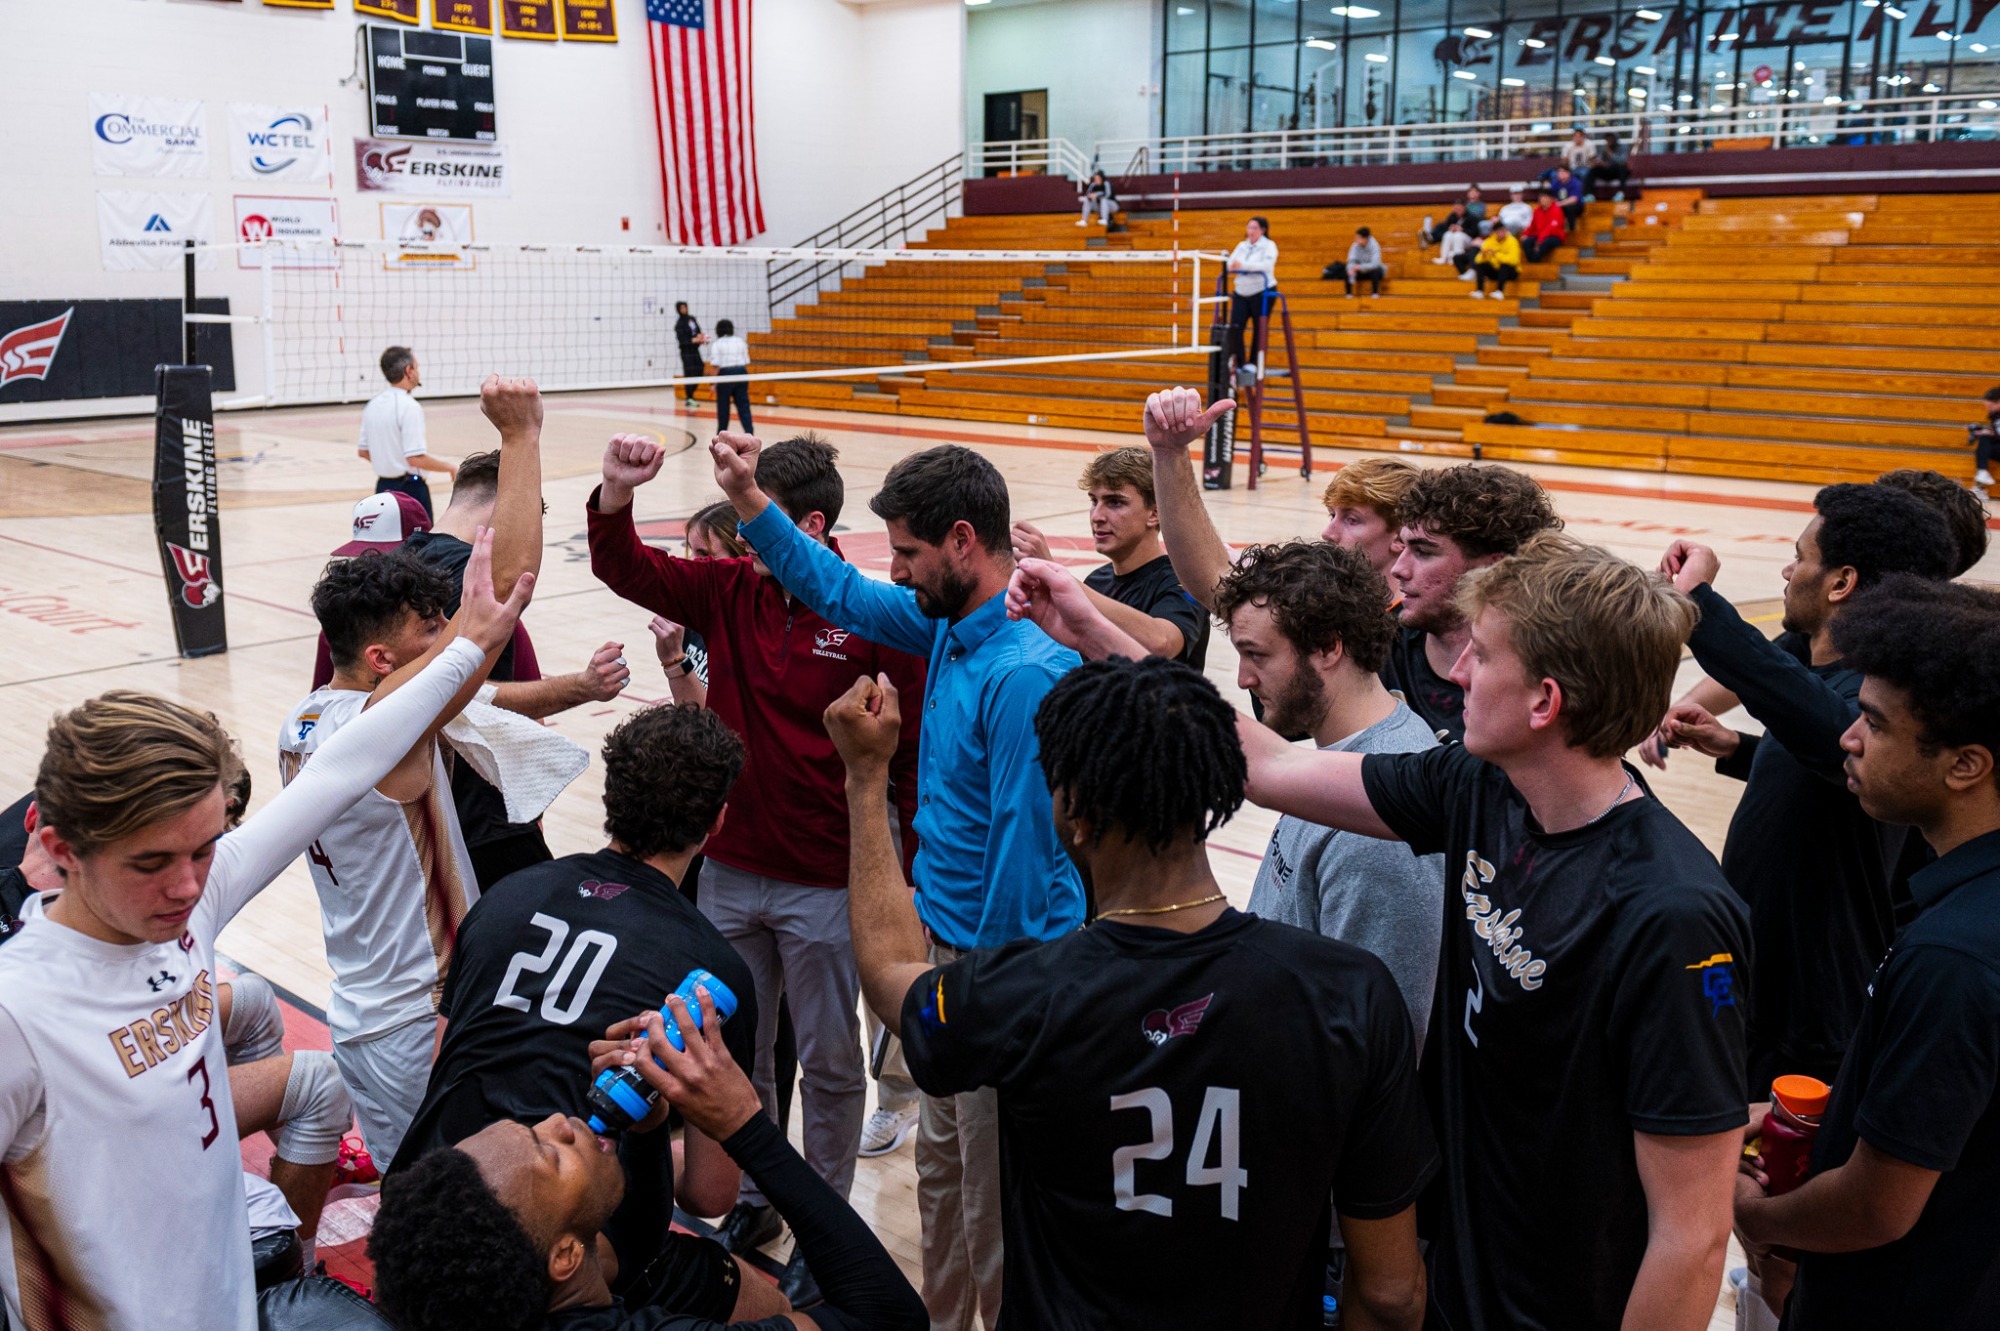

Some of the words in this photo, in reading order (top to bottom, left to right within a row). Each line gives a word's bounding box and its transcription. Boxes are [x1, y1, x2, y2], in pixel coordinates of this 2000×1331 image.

[1516, 0, 1842, 66] ERSKINE
[377, 55, 406, 70] HOME
[461, 63, 490, 77] GUEST
[95, 113, 201, 144] COMMERCIAL
[248, 132, 315, 148] WCTEL
[410, 161, 503, 178] ERSKINE
[203, 421, 215, 462] FLEET
[183, 418, 209, 550] ERSKINE
[205, 463, 218, 515] FLYING
[812, 648, 848, 661] VOLLEYBALL
[1462, 850, 1546, 990] Erskine
[493, 911, 618, 1025] 20
[108, 969, 214, 1079] ERSKINE
[187, 1055, 219, 1152] 3
[1110, 1086, 1248, 1222] 24
